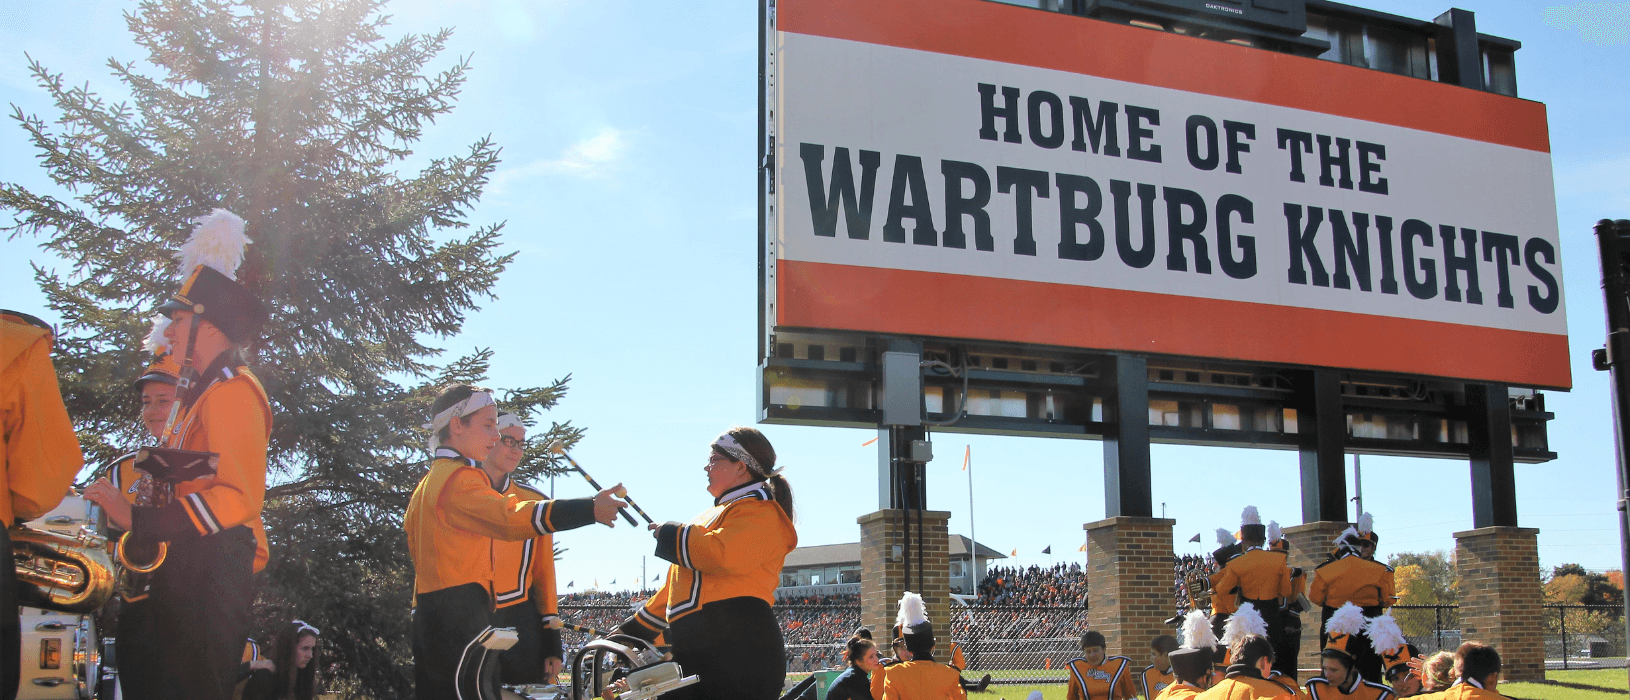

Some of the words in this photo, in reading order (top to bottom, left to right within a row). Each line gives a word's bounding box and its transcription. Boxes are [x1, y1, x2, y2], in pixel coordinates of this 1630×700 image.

[1205, 3, 1243, 15] DAKTRONICS
[978, 83, 1163, 164] HOME
[1186, 115, 1256, 175] OF
[1277, 128, 1389, 196] THE
[799, 143, 1257, 280] WARTBURG
[1283, 203, 1560, 315] KNIGHTS
